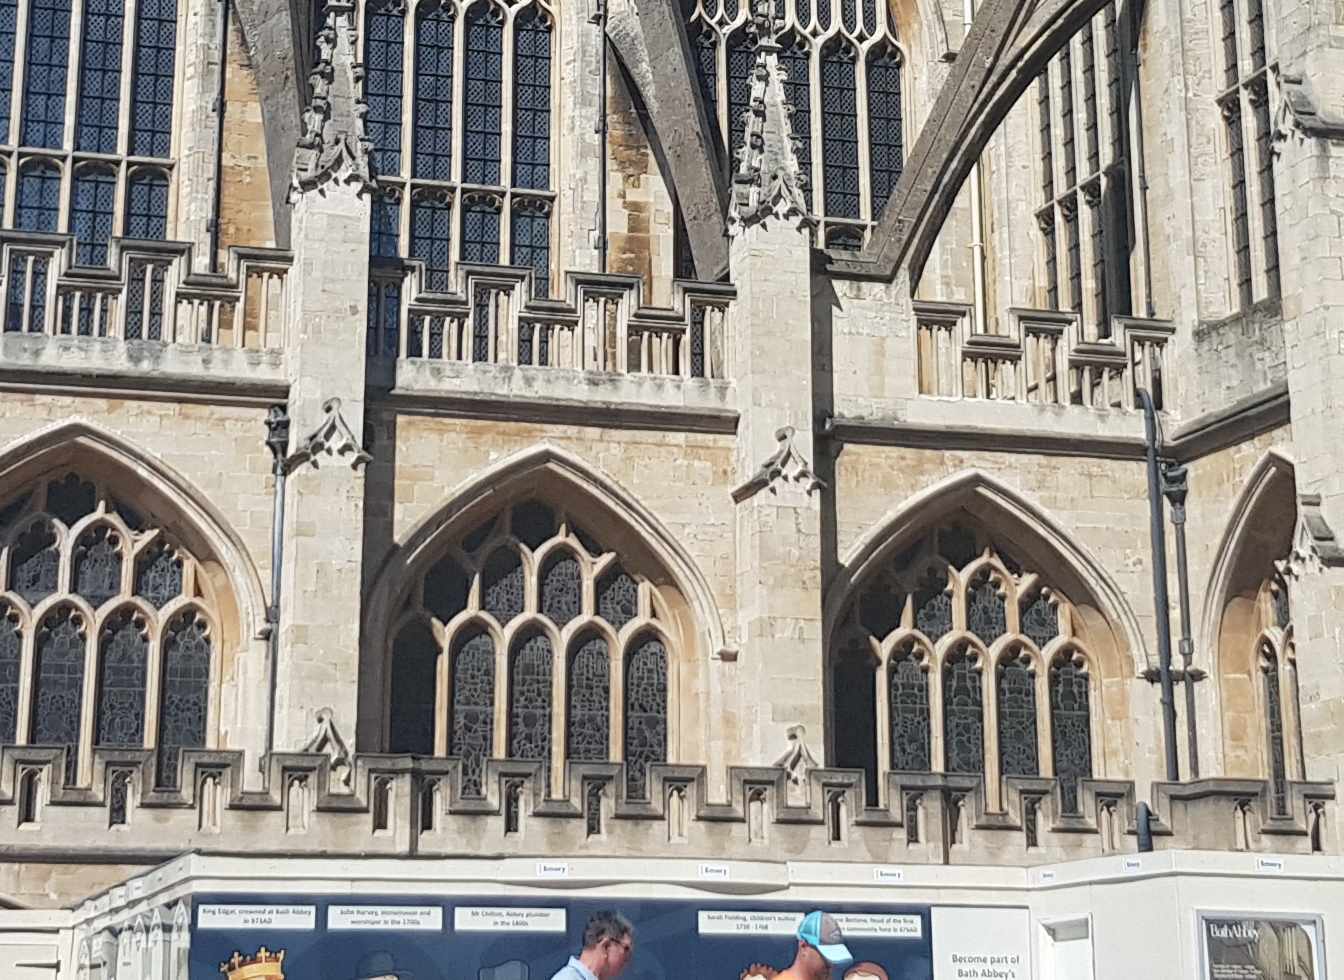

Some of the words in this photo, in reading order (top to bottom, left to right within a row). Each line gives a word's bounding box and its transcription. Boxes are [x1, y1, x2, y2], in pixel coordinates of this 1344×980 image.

[291, 908, 312, 917] Abbey
[952, 954, 988, 964] Become
[990, 955, 1008, 966] part
[1010, 954, 1020, 964] of
[957, 968, 979, 978] Bath
[980, 968, 1016, 980] Abbey's
